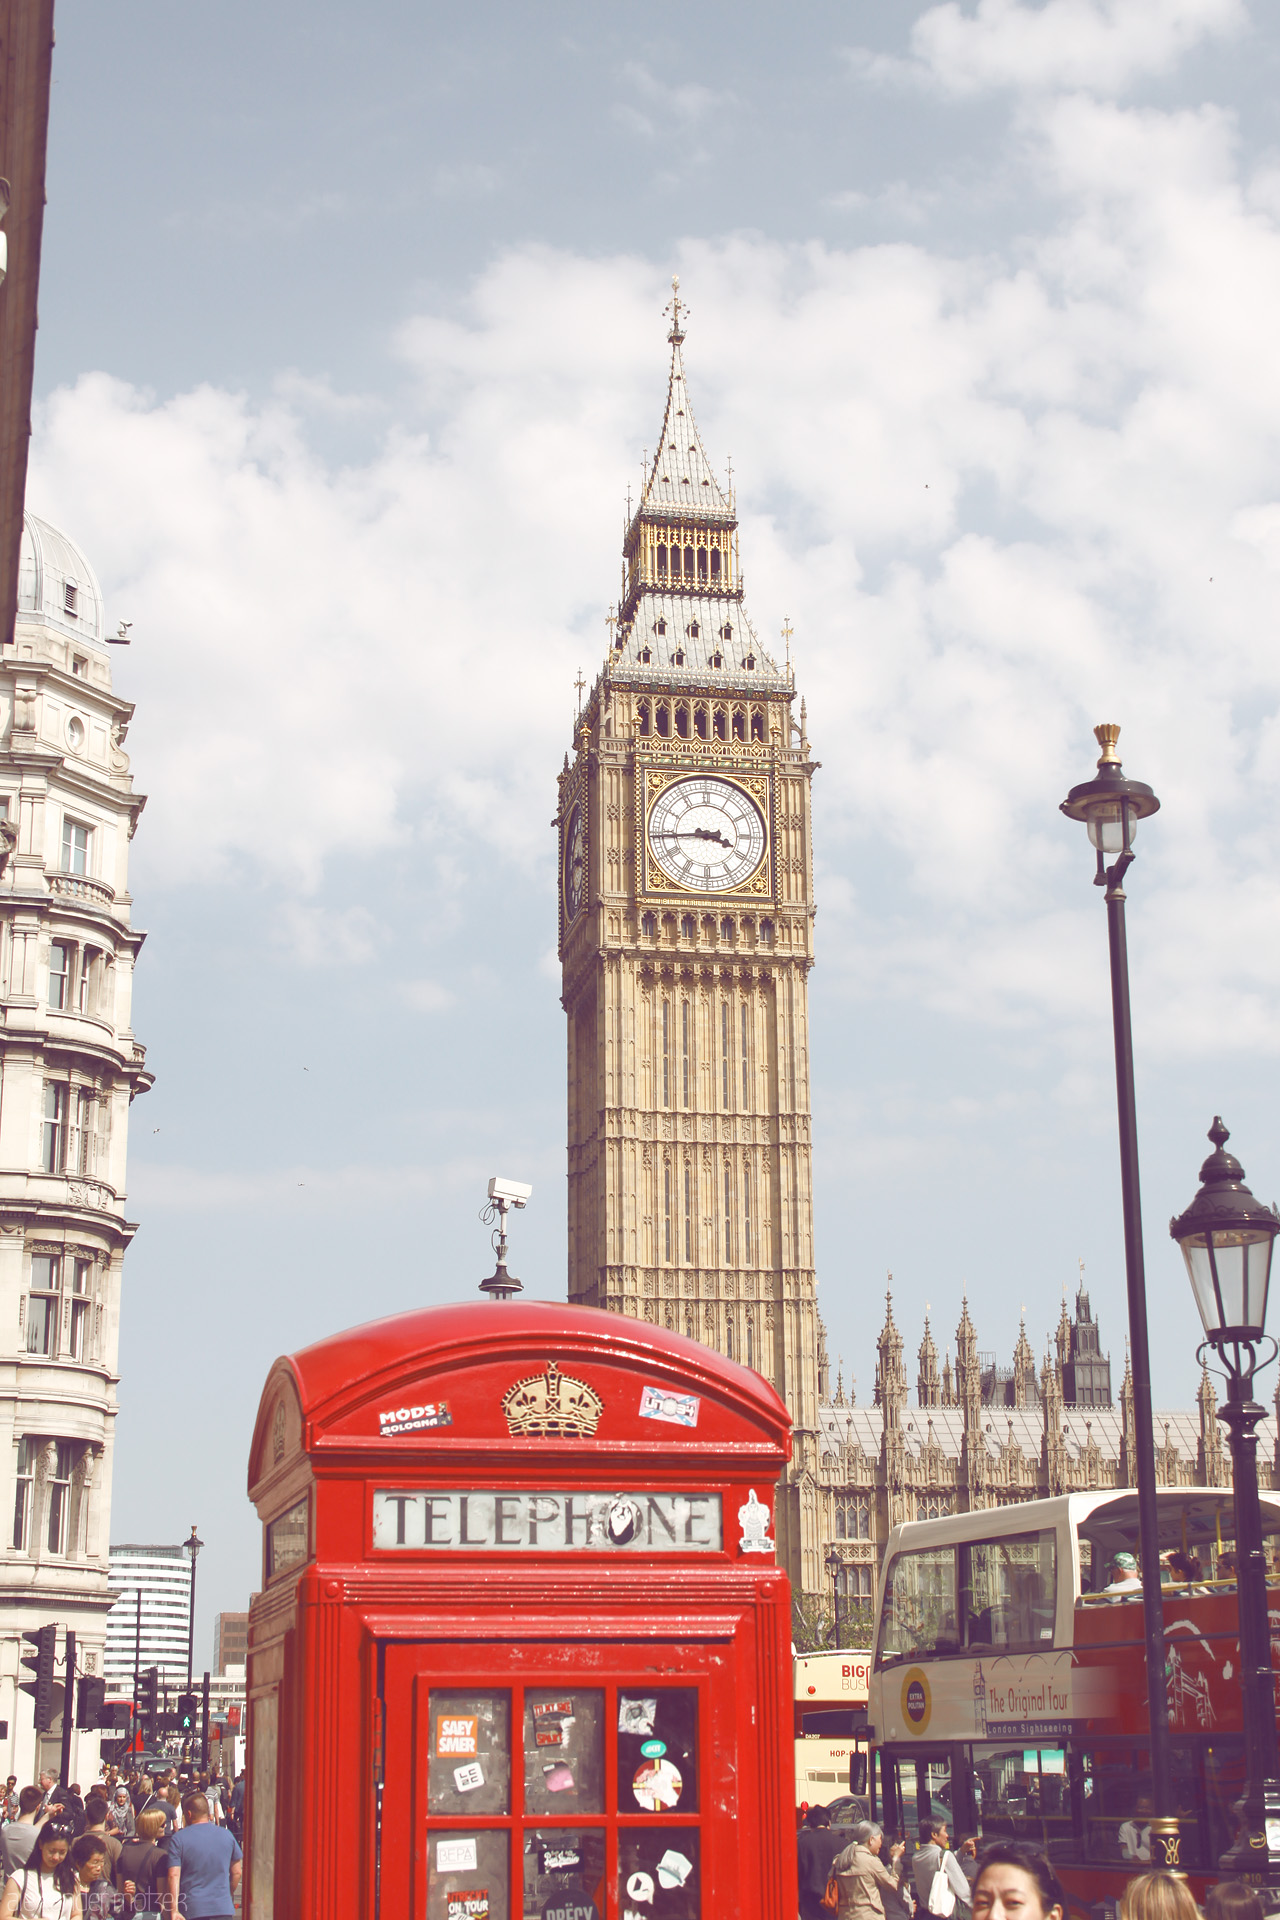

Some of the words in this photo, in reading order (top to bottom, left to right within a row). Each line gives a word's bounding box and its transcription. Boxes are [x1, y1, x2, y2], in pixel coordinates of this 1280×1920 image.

[382, 1417, 438, 1434] BOLOGNA
[385, 1495, 711, 1546] TELEPHONE
[842, 1665, 865, 1677] BIG
[842, 1678, 866, 1691] BUS
[908, 1702, 925, 1710] POLITAN
[989, 1687, 1005, 1713] The
[1008, 1684, 1046, 1719] Original
[1048, 1685, 1069, 1711] Tour
[442, 1720, 474, 1736] SAEY
[988, 1725, 1017, 1734] London
[1021, 1723, 1073, 1735] Sightseeing
[439, 1737, 476, 1753] SMER
[447, 1889, 489, 1904] UTRECHT
[448, 1902, 462, 1914] ON
[464, 1899, 489, 1915] TOUR
